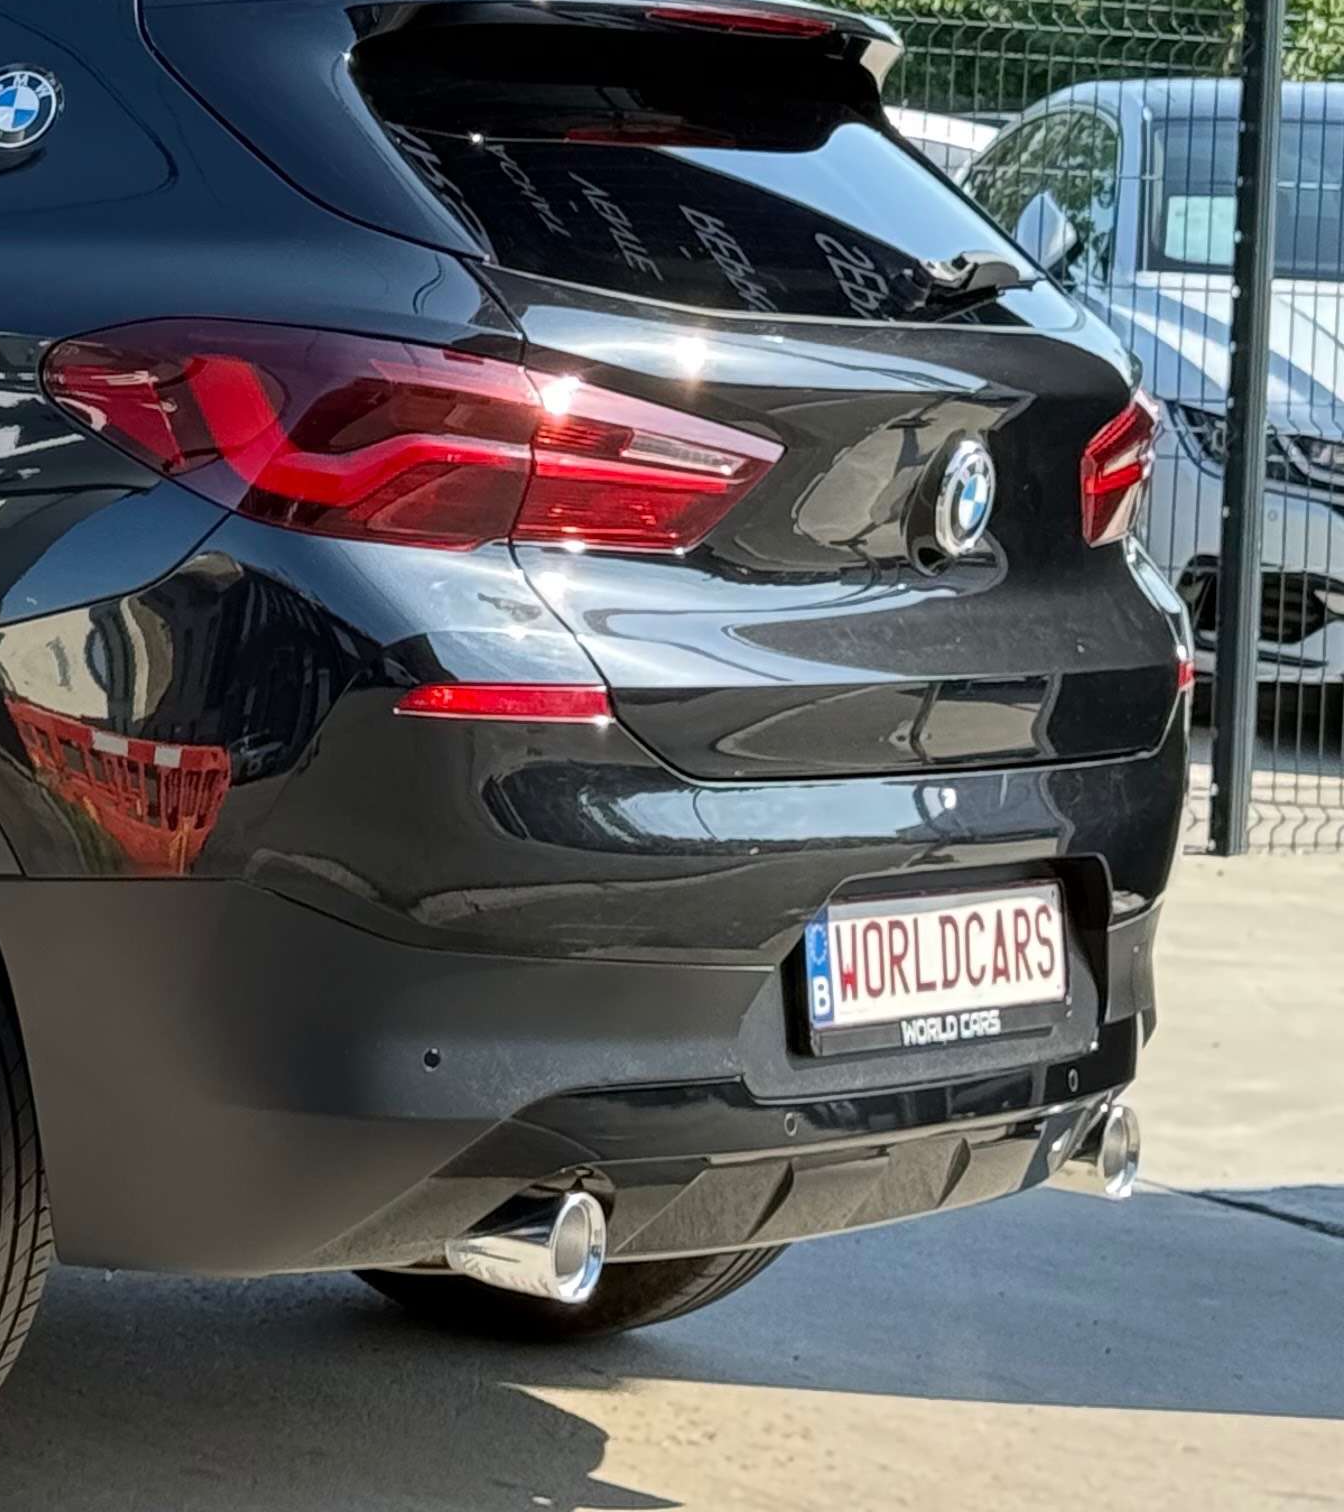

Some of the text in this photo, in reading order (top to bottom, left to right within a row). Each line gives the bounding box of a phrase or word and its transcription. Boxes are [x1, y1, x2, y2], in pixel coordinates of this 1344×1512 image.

[835, 904, 1055, 1002] WORLDCARS
[813, 976, 831, 1015] B
[901, 1009, 1001, 1046] WORLD CARS
